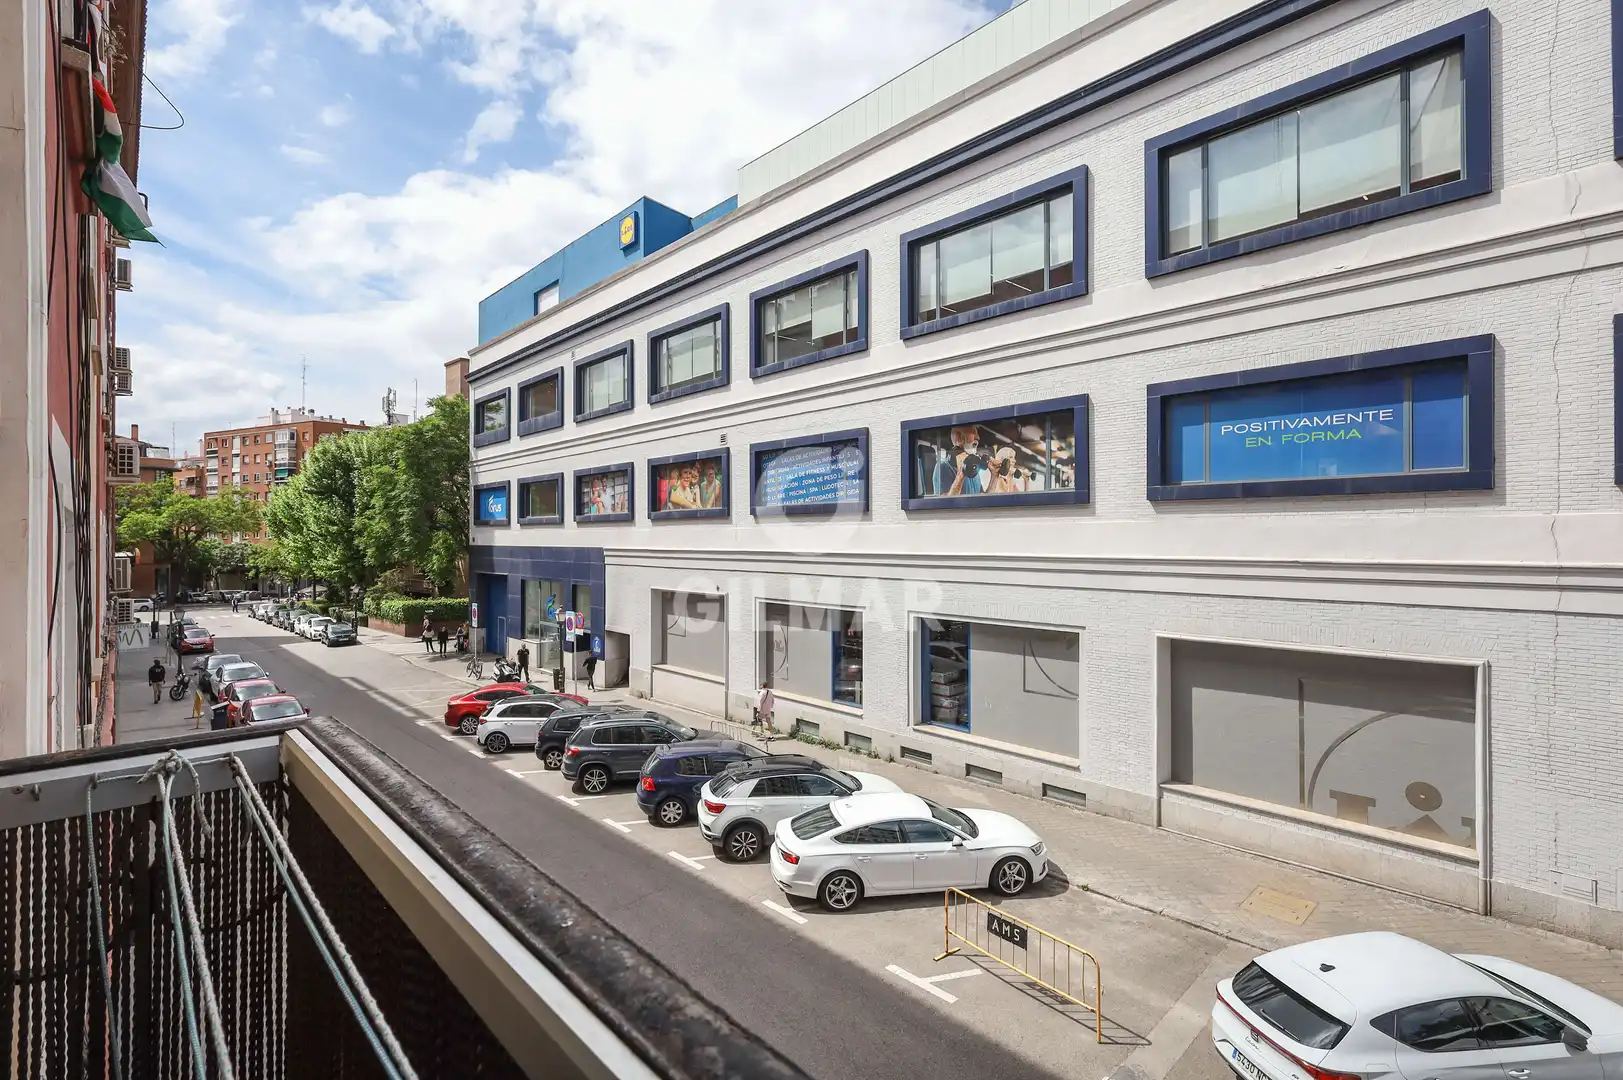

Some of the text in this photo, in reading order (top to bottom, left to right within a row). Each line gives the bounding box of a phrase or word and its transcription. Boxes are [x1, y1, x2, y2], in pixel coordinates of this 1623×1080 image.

[1221, 409, 1394, 435] POSITIVAMENTE
[1245, 428, 1363, 448] EN FORMA
[802, 477, 816, 486] ZONA
[824, 473, 838, 481] PESO
[788, 489, 806, 498] PISCINA
[992, 919, 1020, 941] AMS
[1236, 1053, 1255, 1074] 5430
